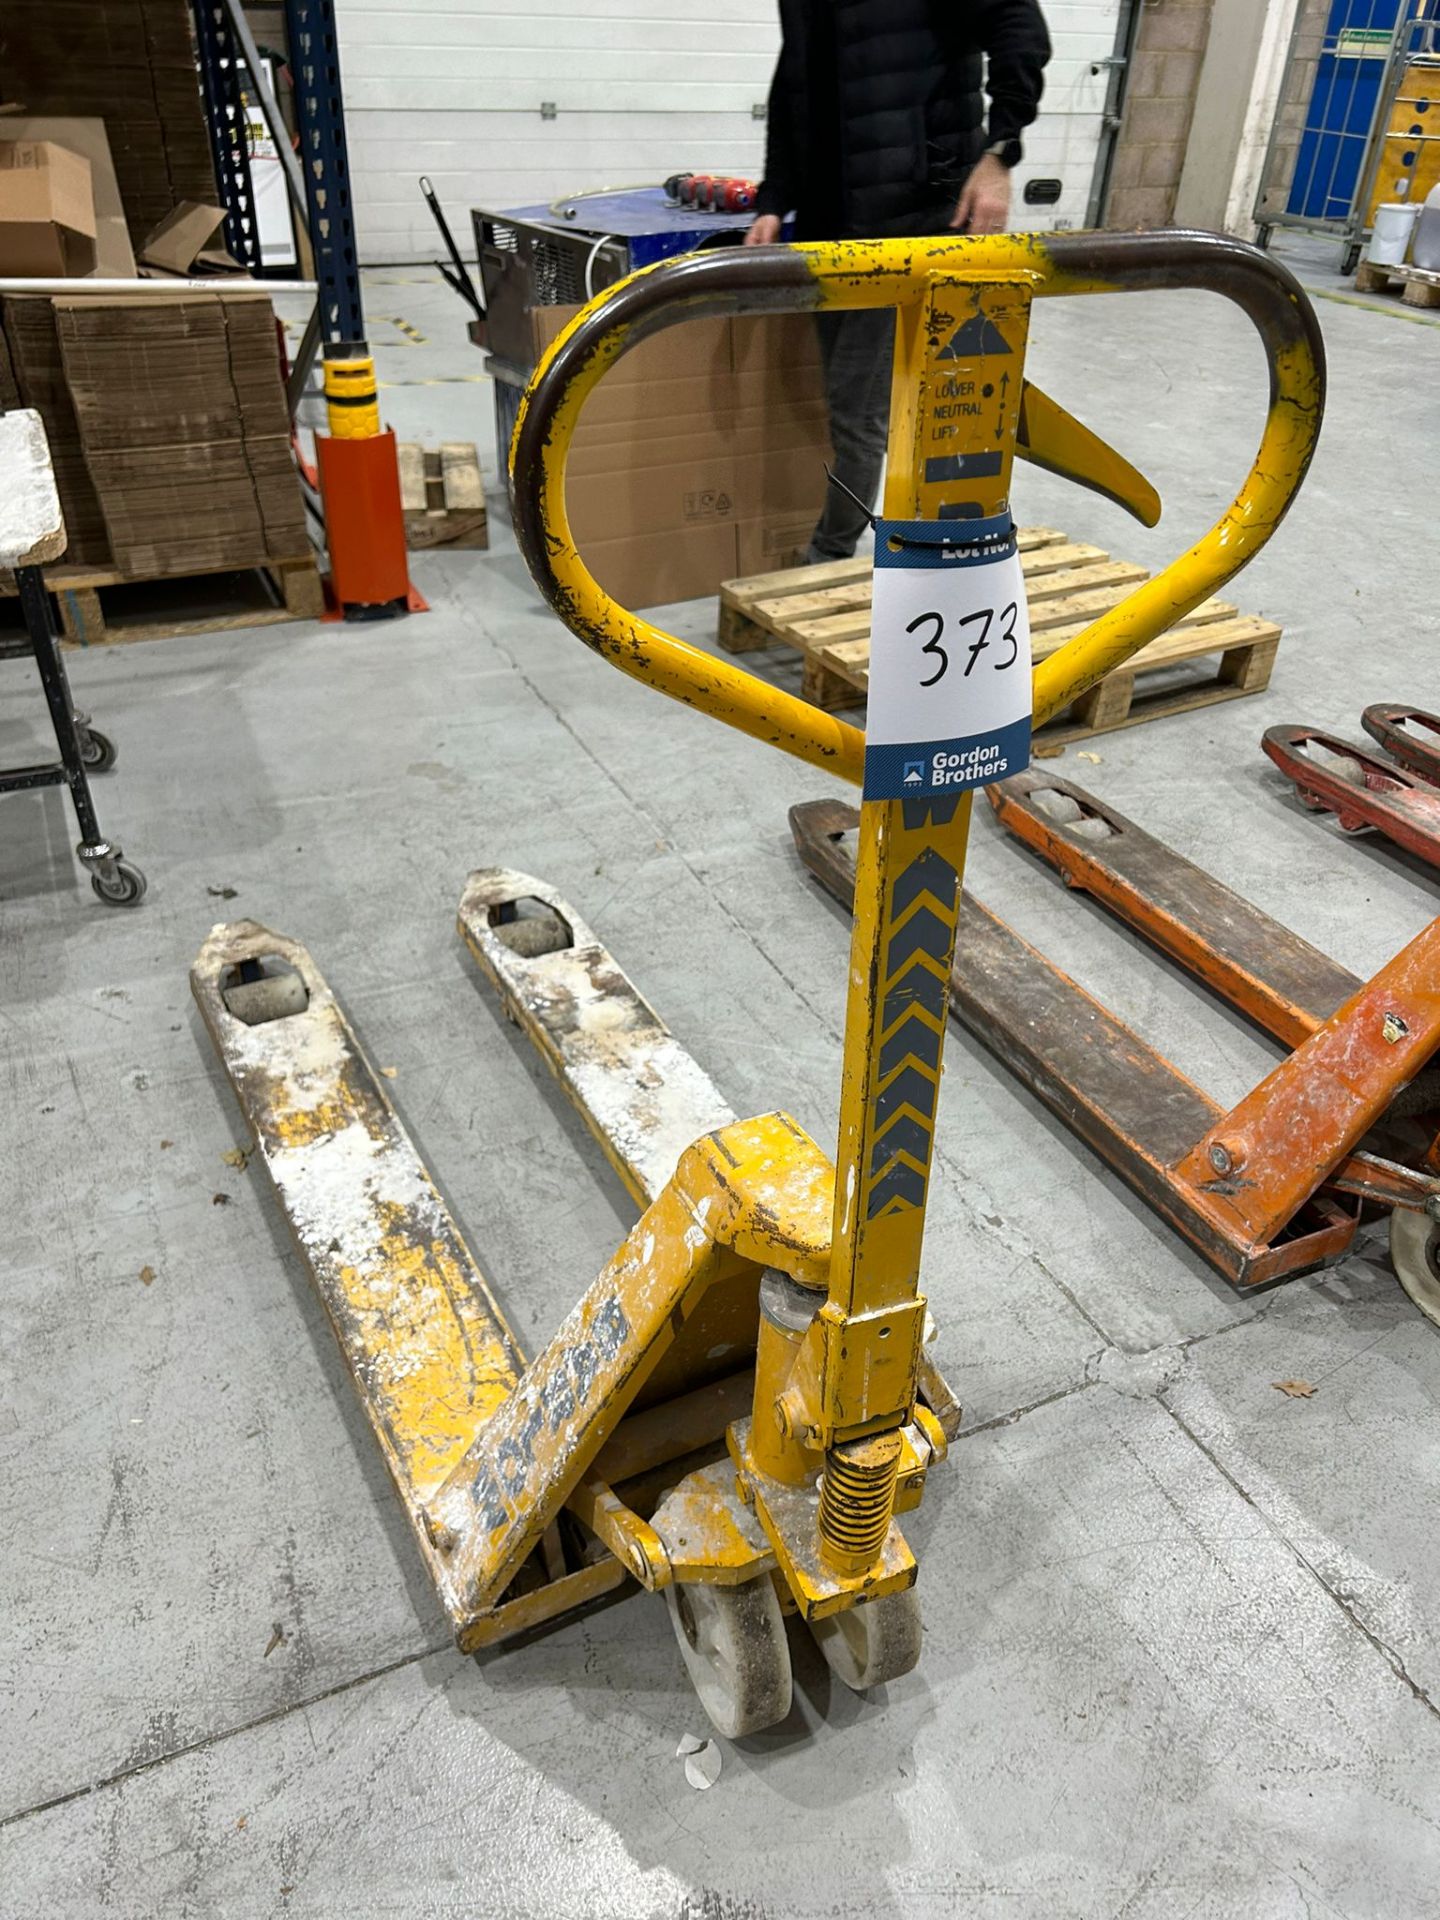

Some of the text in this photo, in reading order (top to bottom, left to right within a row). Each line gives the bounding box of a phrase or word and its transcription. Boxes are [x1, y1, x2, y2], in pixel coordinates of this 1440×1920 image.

[935, 381, 976, 399] LOWER
[933, 402, 983, 419] NEUTRAL
[932, 424, 955, 441] LIFT
[905, 601, 1019, 687] 373
[932, 745, 1000, 769] Gordon
[931, 757, 1008, 786] Brothers
